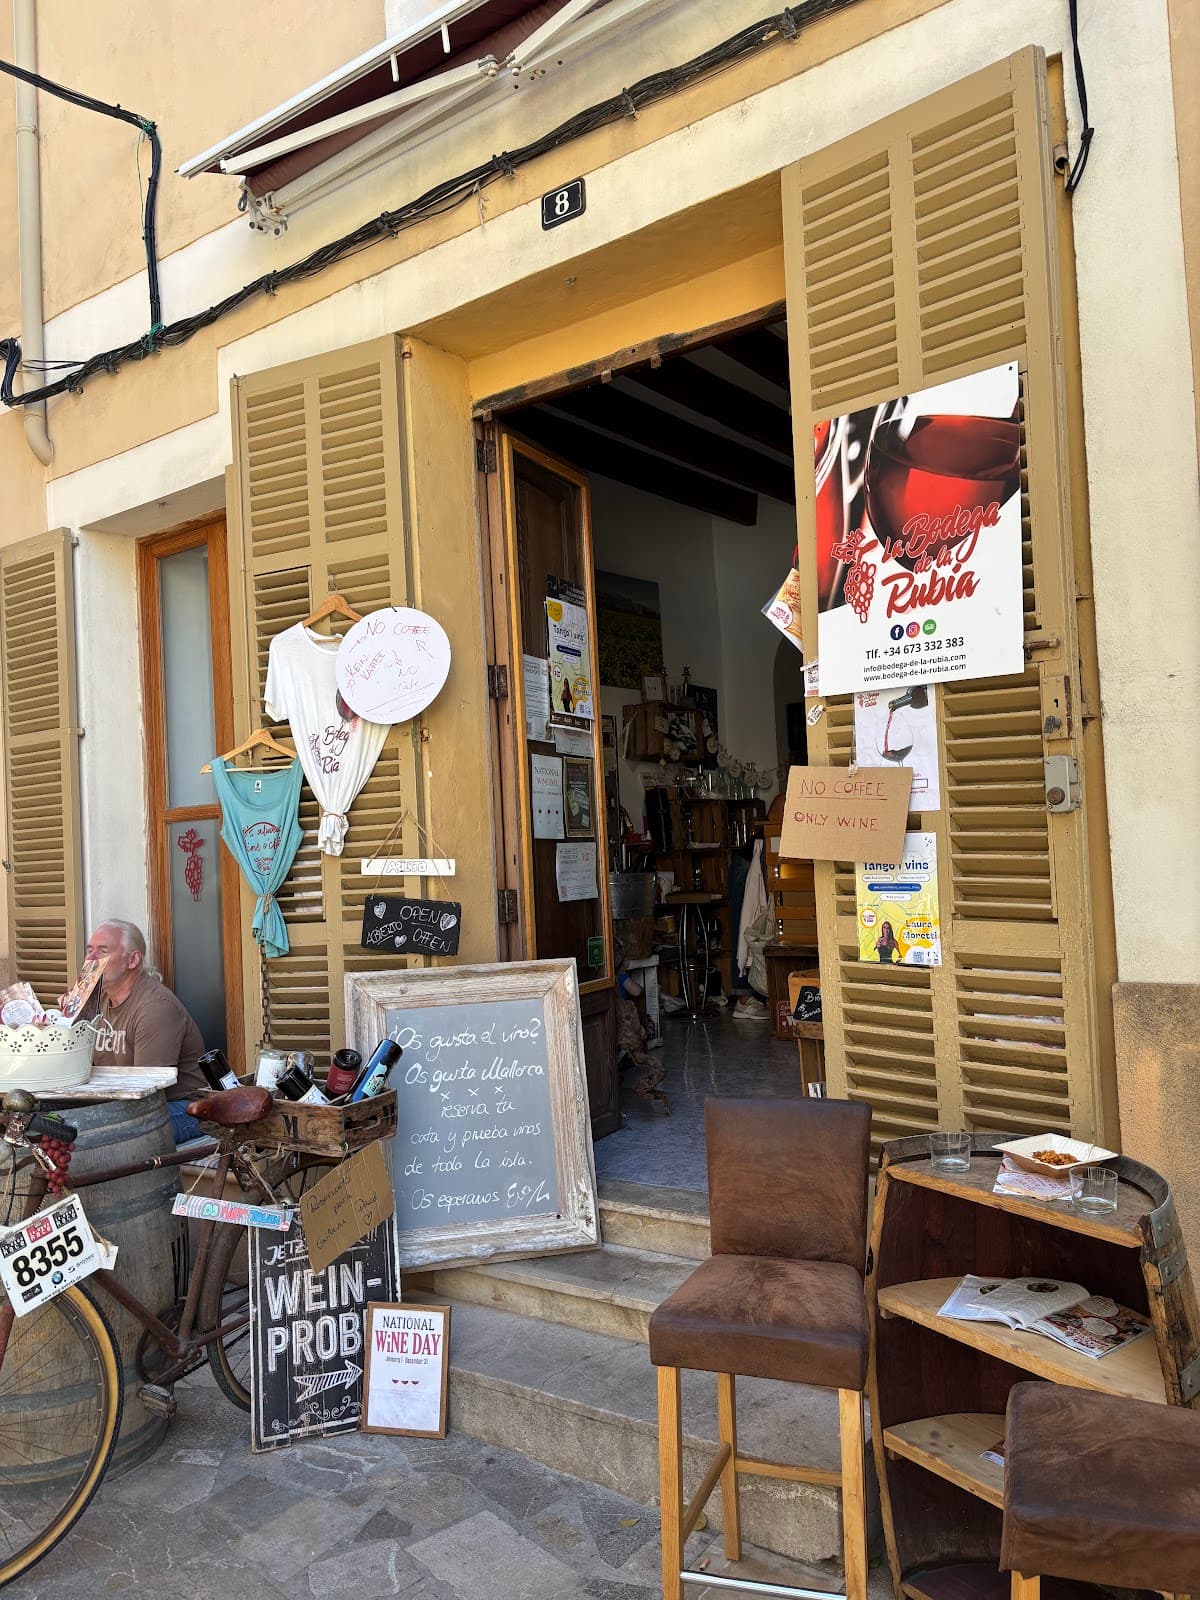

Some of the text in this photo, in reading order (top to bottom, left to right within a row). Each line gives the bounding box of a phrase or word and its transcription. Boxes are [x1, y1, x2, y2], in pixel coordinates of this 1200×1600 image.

[554, 190, 570, 216] 8
[881, 501, 1001, 563] La Bodega
[914, 544, 953, 574] de la
[881, 563, 981, 619] Rubia
[366, 619, 386, 636] NO
[865, 636, 964, 660] Tlf. +34 673 332 383
[863, 653, 967, 673] info@bodega-de-la-rubia.com
[863, 663, 967, 682] www.bodega-de-la-rubia.com
[800, 779, 885, 797] NO COFFEE
[794, 811, 879, 832] ONLY WINE
[400, 905, 442, 924] OPEN
[412, 928, 452, 952] OFFEN
[425, 1026, 478, 1062] gusta
[481, 1022, 497, 1045] el
[404, 1056, 545, 1093] Os gusta Mallorca
[495, 1093, 518, 1114] tu
[410, 1121, 542, 1153] cata y prueba vinos
[404, 1157, 424, 1177] de
[411, 1188, 434, 1210] Os
[12, 1225, 84, 1287] 8355
[264, 1260, 383, 1321] WEIN-
[382, 1316, 435, 1331] NATIONAL
[267, 1308, 368, 1373] PROB
[412, 1332, 441, 1356] DAY
